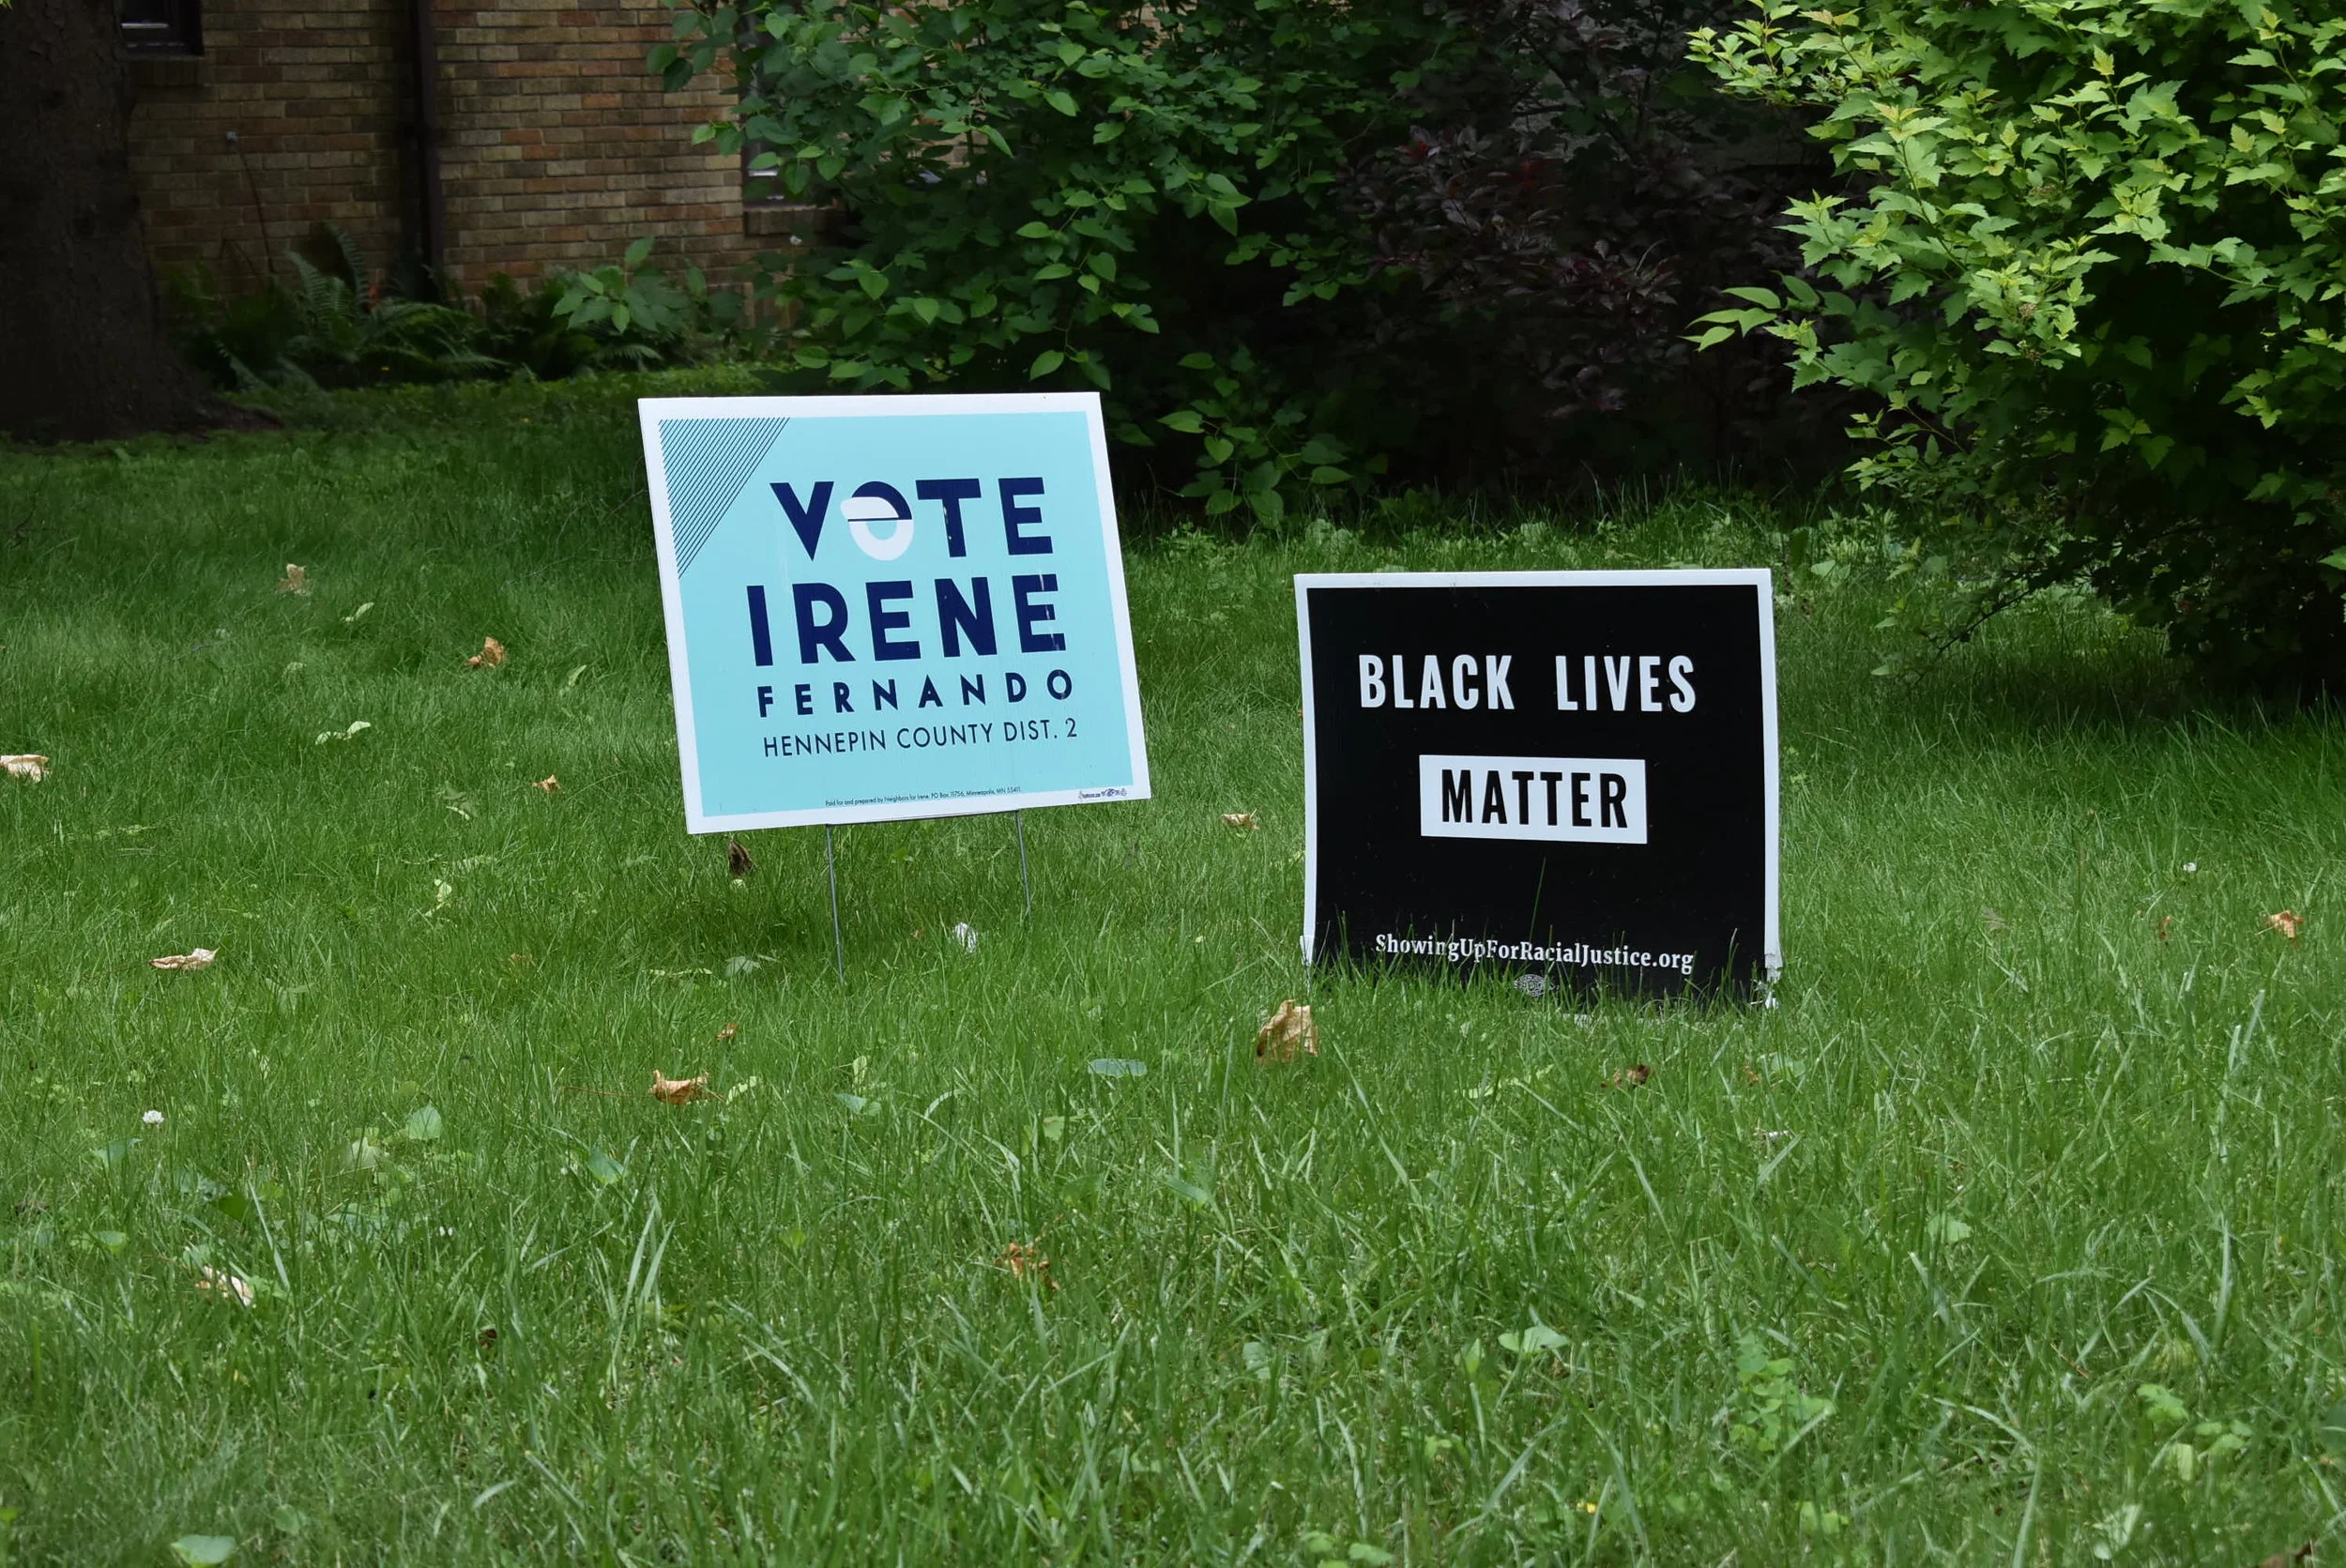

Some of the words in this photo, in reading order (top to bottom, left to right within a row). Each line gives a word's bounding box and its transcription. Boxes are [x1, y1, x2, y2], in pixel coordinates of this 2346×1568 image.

[769, 477, 1053, 561] VOTE
[746, 573, 1066, 667] IRENE
[756, 669, 1073, 718] FERNANDO
[1359, 654, 1515, 710] BLACK
[1555, 655, 1697, 713] LIVES
[764, 729, 887, 757] HENNEPIN
[896, 723, 993, 749] COUNTY
[1003, 719, 1059, 741] DIST.
[1064, 717, 1077, 738] 2
[855, 798, 876, 806] prepared
[1441, 769, 1628, 829] MATTER
[1376, 934, 1694, 975] ShowingUpForRacialJustice.org
